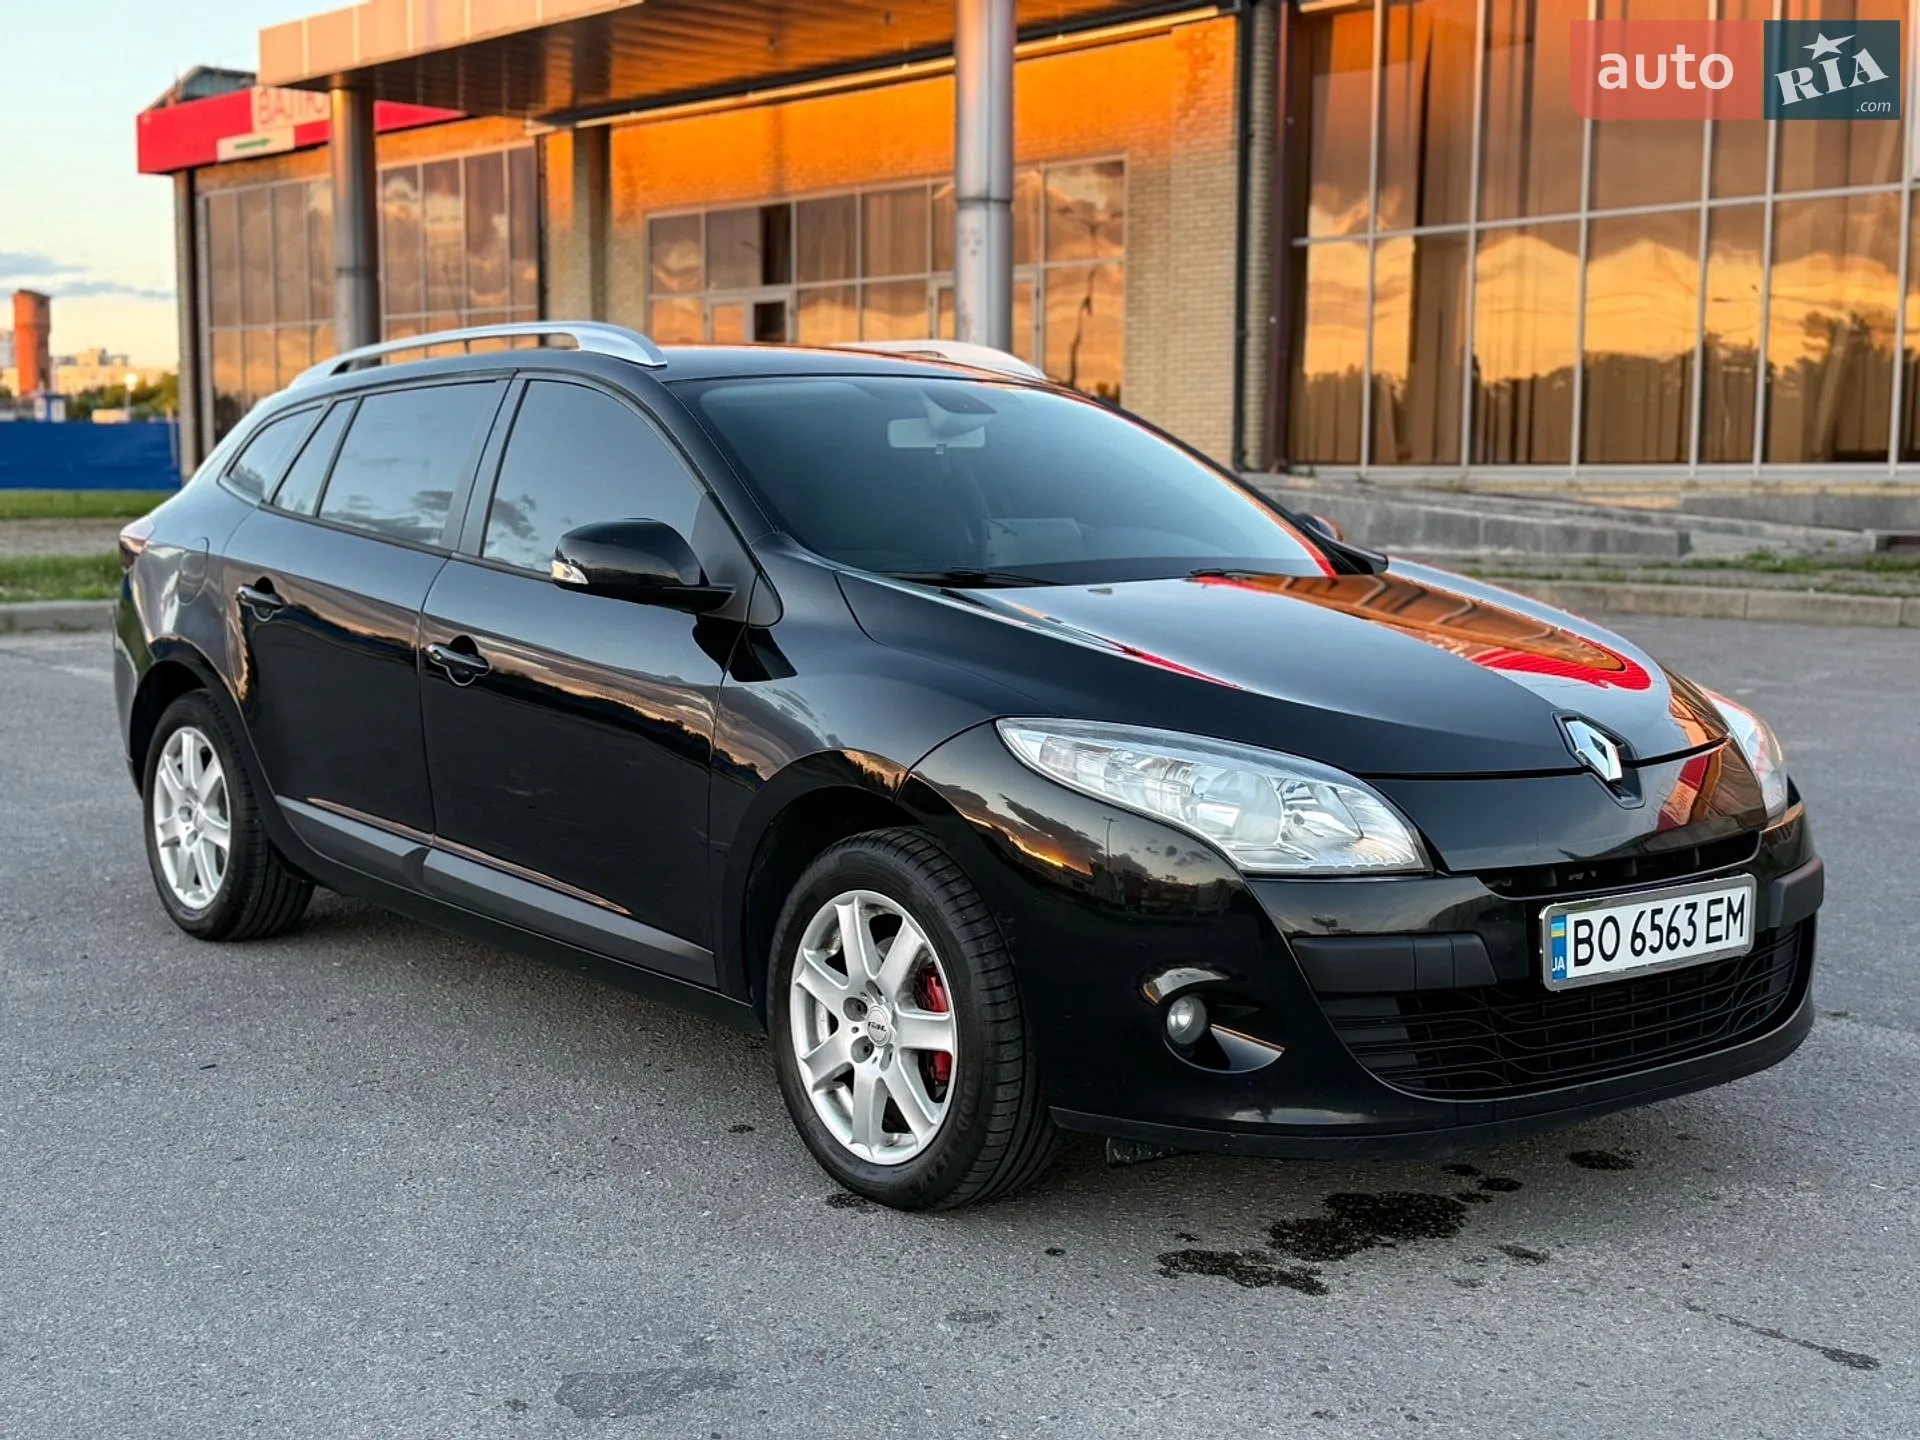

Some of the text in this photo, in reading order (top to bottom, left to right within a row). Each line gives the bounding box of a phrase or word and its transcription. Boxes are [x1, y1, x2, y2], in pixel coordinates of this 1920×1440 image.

[1573, 893, 1746, 968] BO 6563 EM
